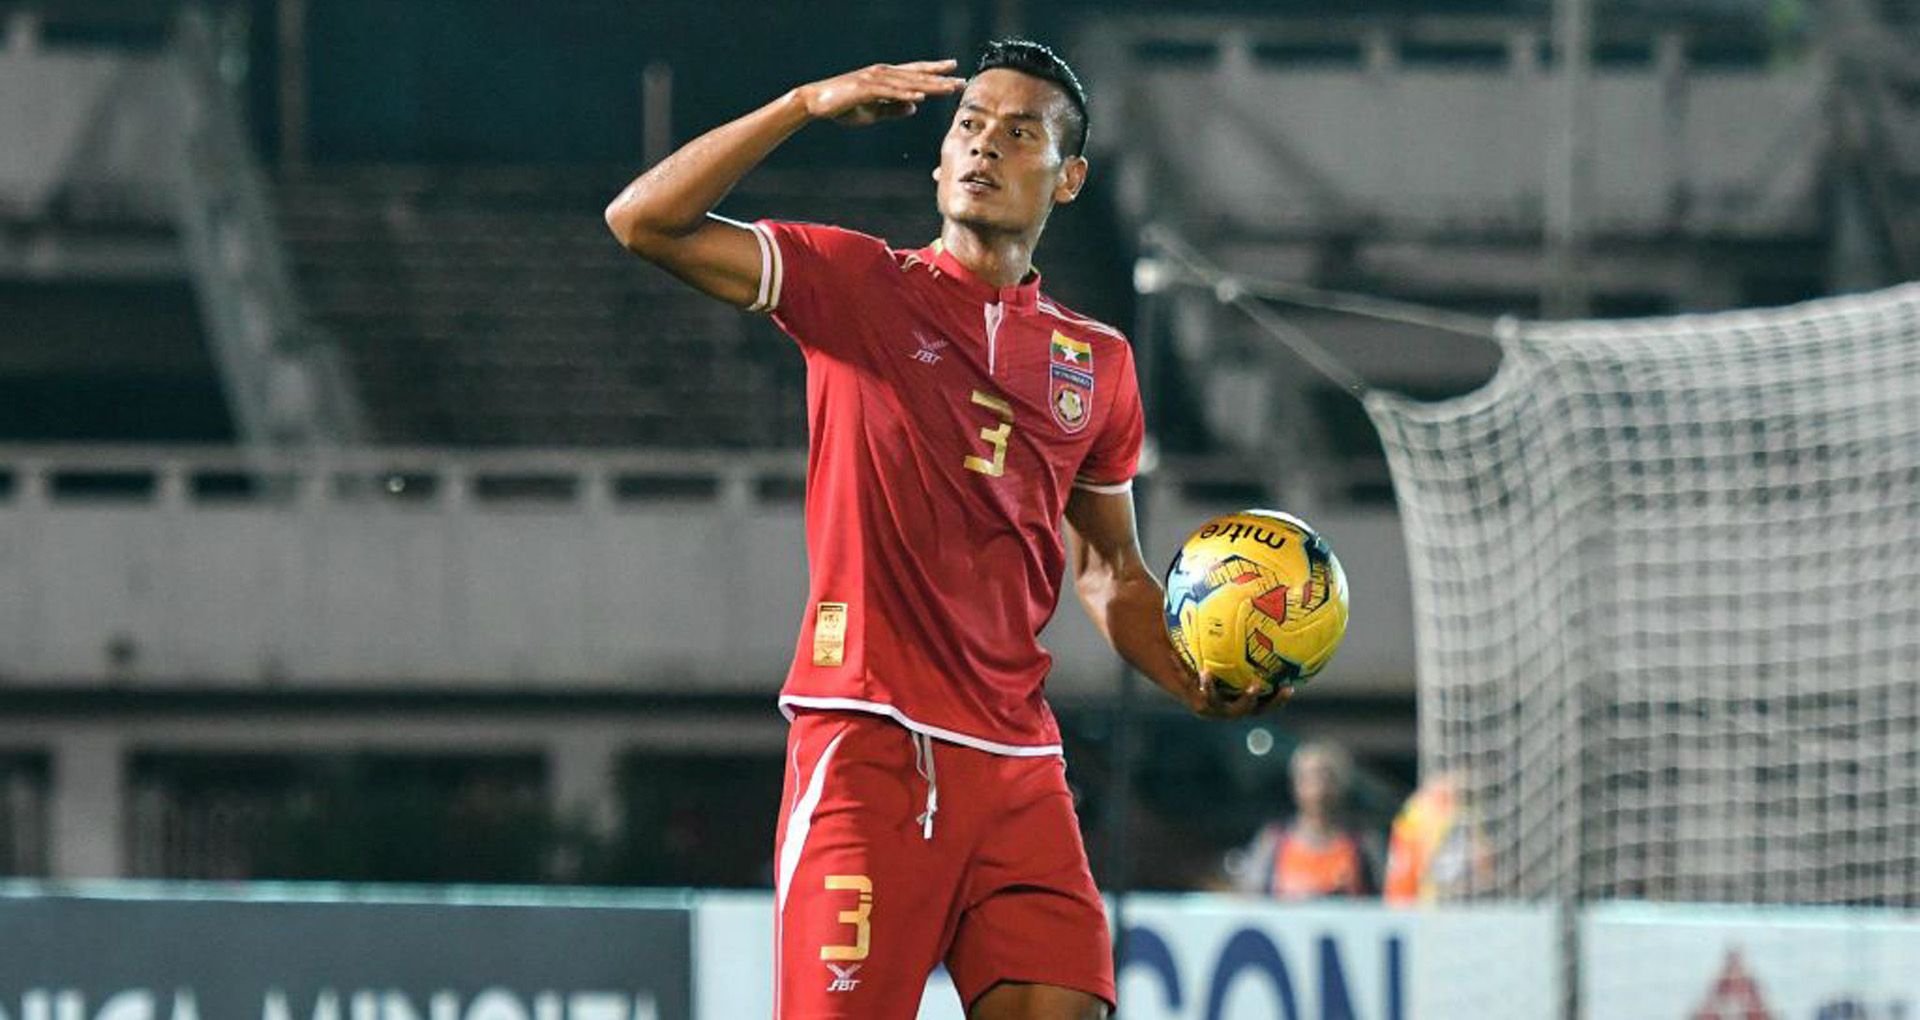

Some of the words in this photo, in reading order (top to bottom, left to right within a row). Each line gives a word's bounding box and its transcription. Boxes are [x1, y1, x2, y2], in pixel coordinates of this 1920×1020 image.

[963, 389, 1014, 478] 3
[1200, 521, 1287, 550] mitre
[820, 874, 873, 961] 3
